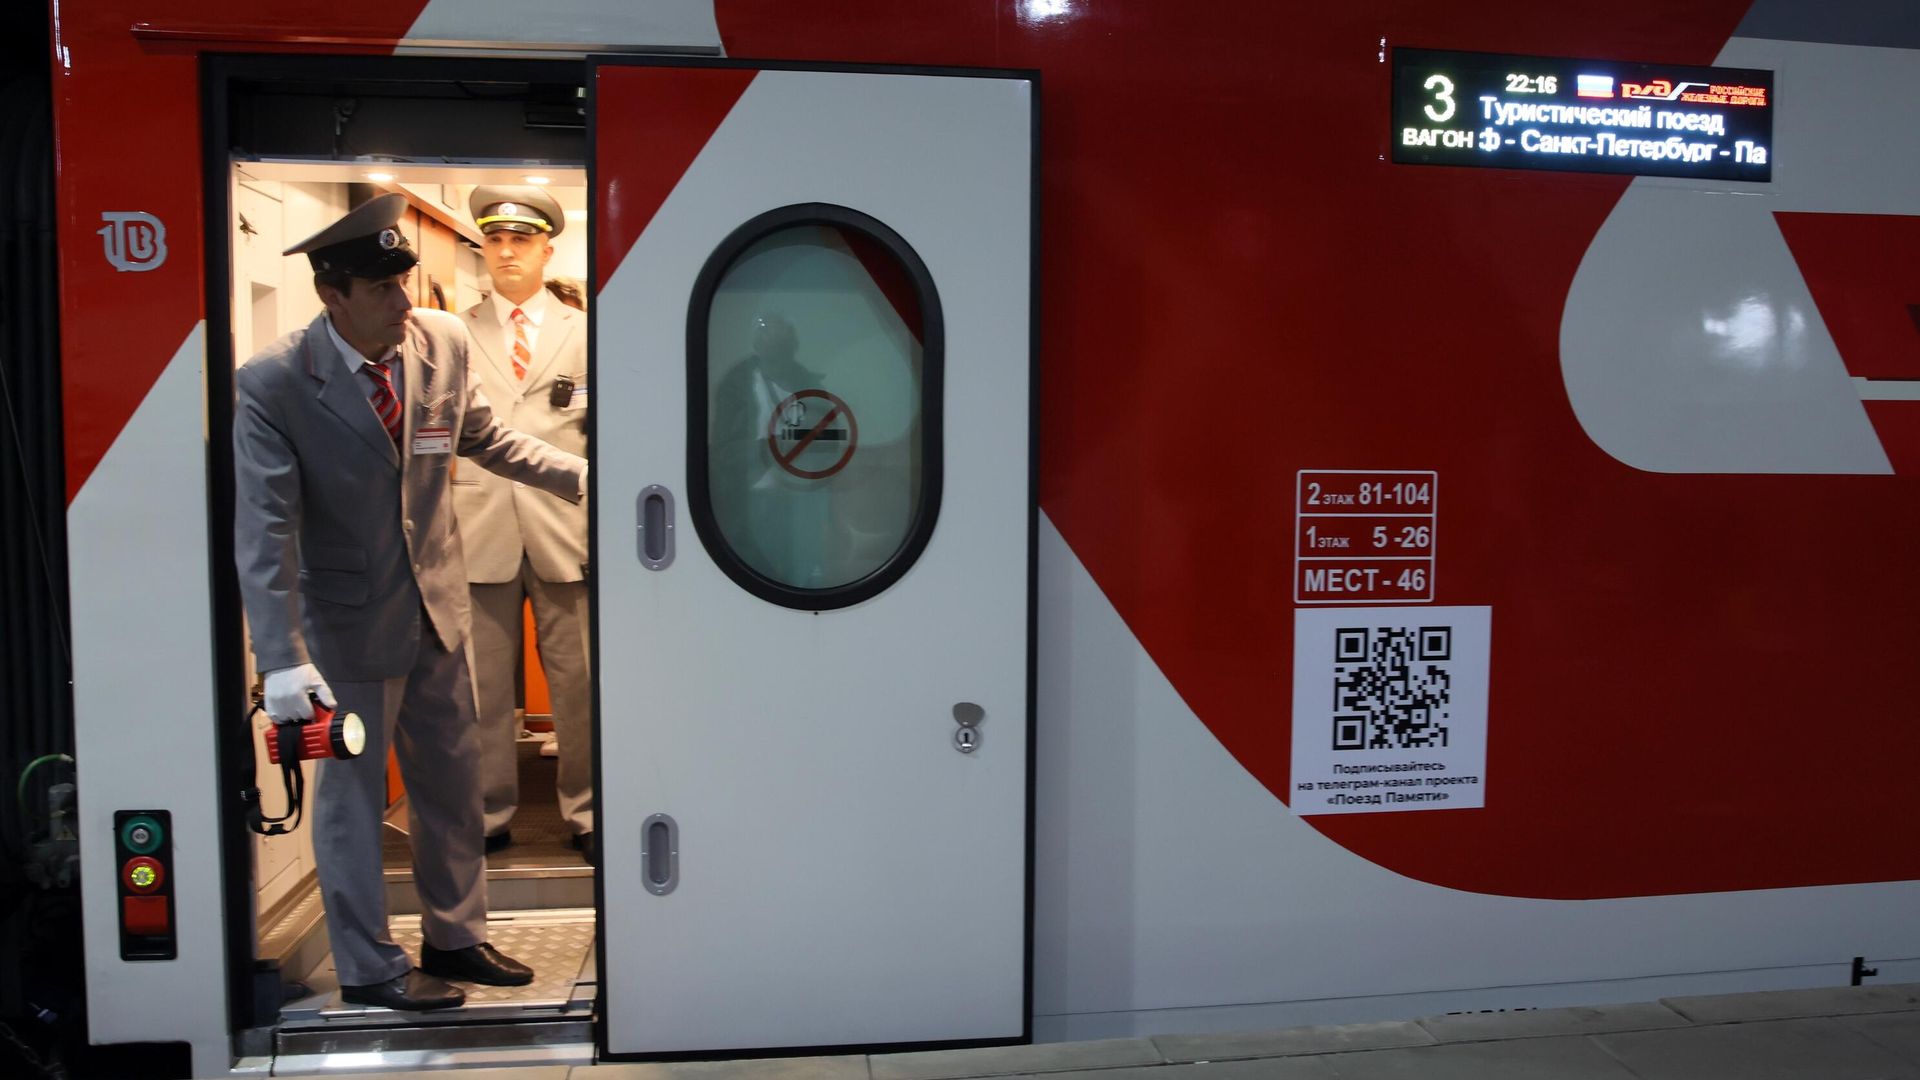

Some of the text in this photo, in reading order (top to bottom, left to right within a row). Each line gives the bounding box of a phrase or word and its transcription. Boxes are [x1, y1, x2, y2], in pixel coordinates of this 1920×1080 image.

[1505, 73, 1557, 94] 22:16
[1424, 74, 1456, 122] 3
[1479, 95, 1726, 136] Туристический поезд
[1402, 127, 1474, 149] ВАГОН
[1521, 129, 1718, 163] Санкт-Петербург
[1734, 140, 1767, 164] Па
[1307, 482, 1430, 505] 2 ЭТАЖ 81-104
[1306, 525, 1317, 548] 1
[1318, 537, 1350, 548] ЭТАЖ
[1304, 569, 1380, 592] МЕСТ
[1397, 568, 1426, 592] 46
[1333, 761, 1446, 775] Подписывайтесь
[1298, 775, 1479, 791] на телеграм-канал проекта
[1327, 791, 1450, 806] «Поезд Памяти»
